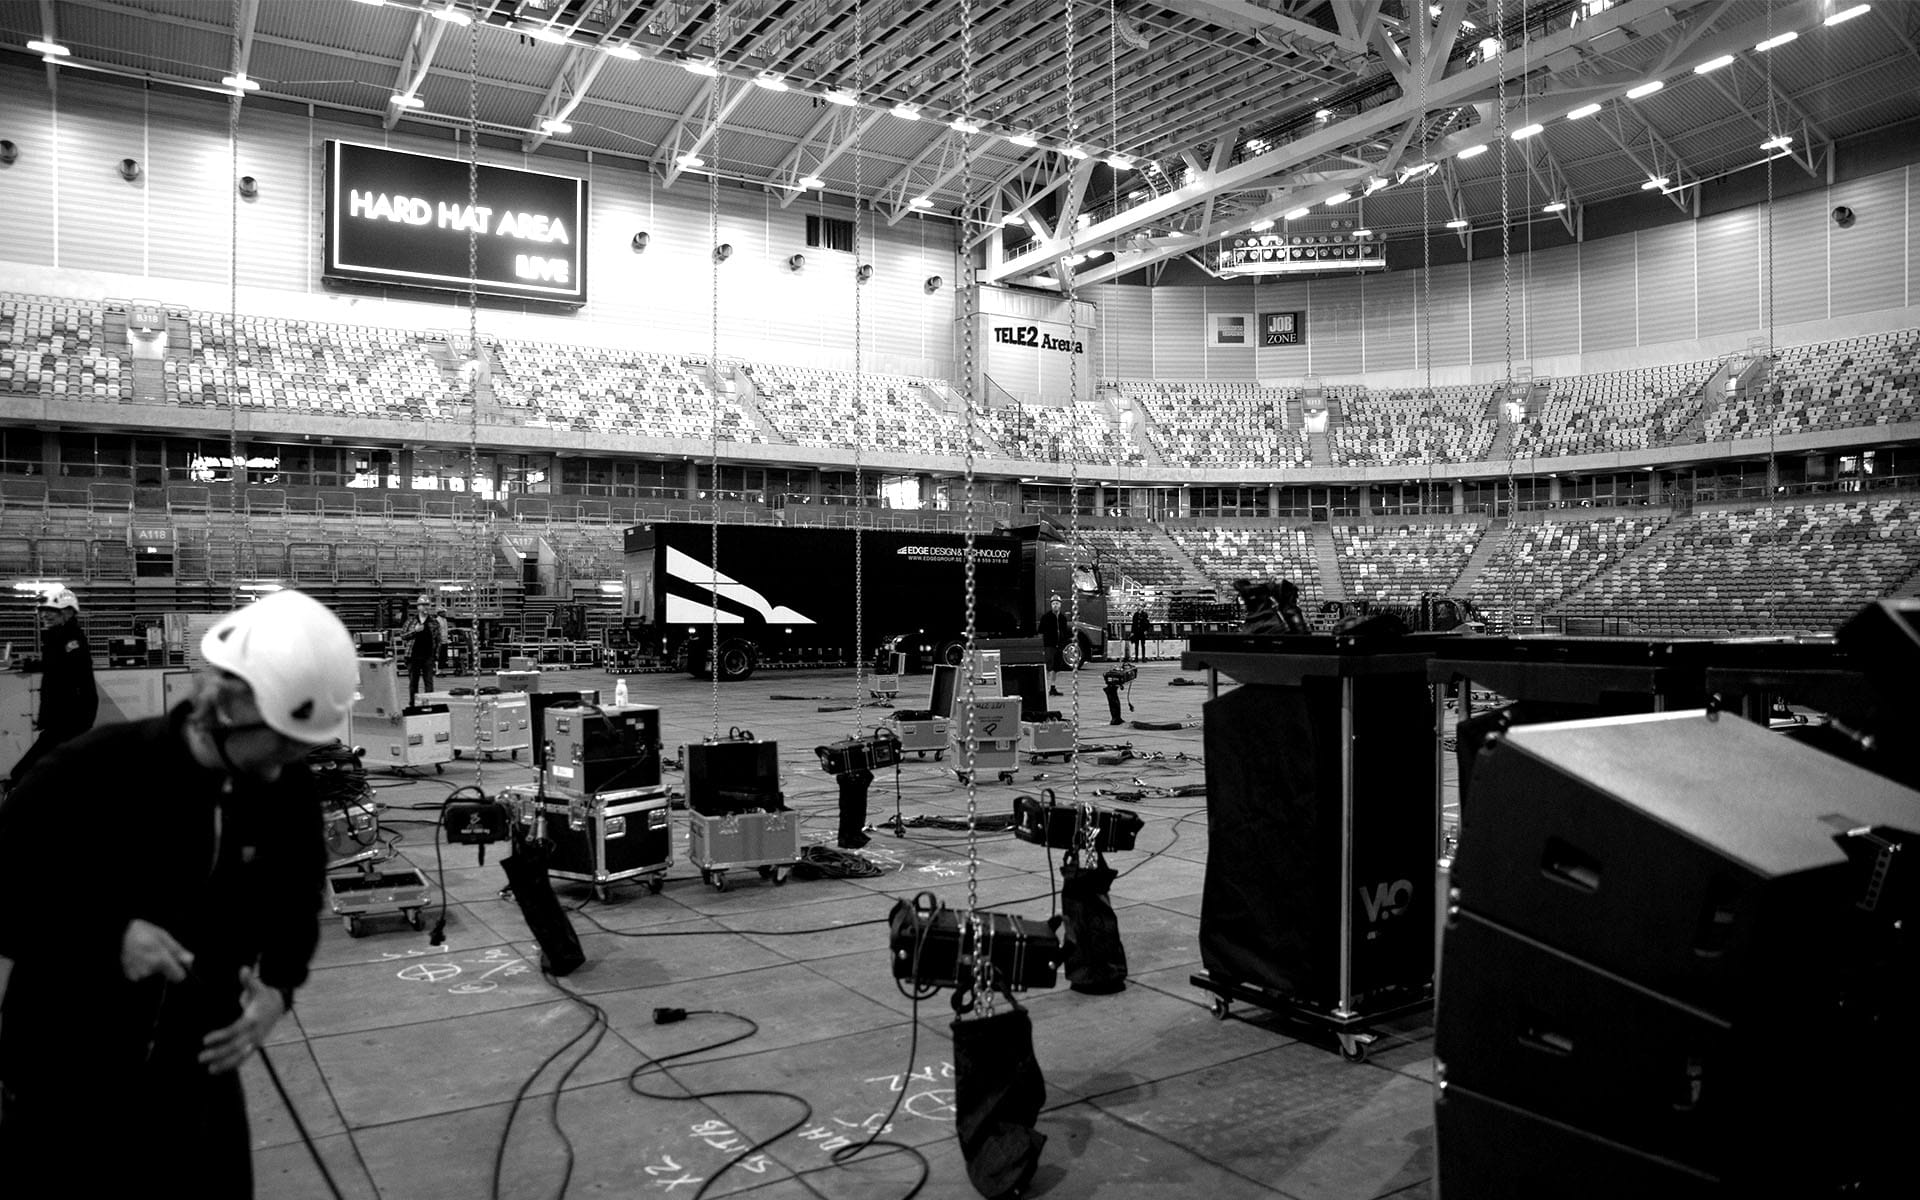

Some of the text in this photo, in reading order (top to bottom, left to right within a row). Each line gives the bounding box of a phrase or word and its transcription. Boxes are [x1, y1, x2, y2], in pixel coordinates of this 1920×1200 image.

[350, 189, 569, 245] HARD HAT AREA
[1269, 316, 1292, 333] JOB
[994, 326, 1038, 348] TELE2
[1267, 333, 1297, 345] ZONE
[139, 530, 166, 539] A118
[908, 546, 1011, 558] EDGE DESIGN&TCHNOLOGY
